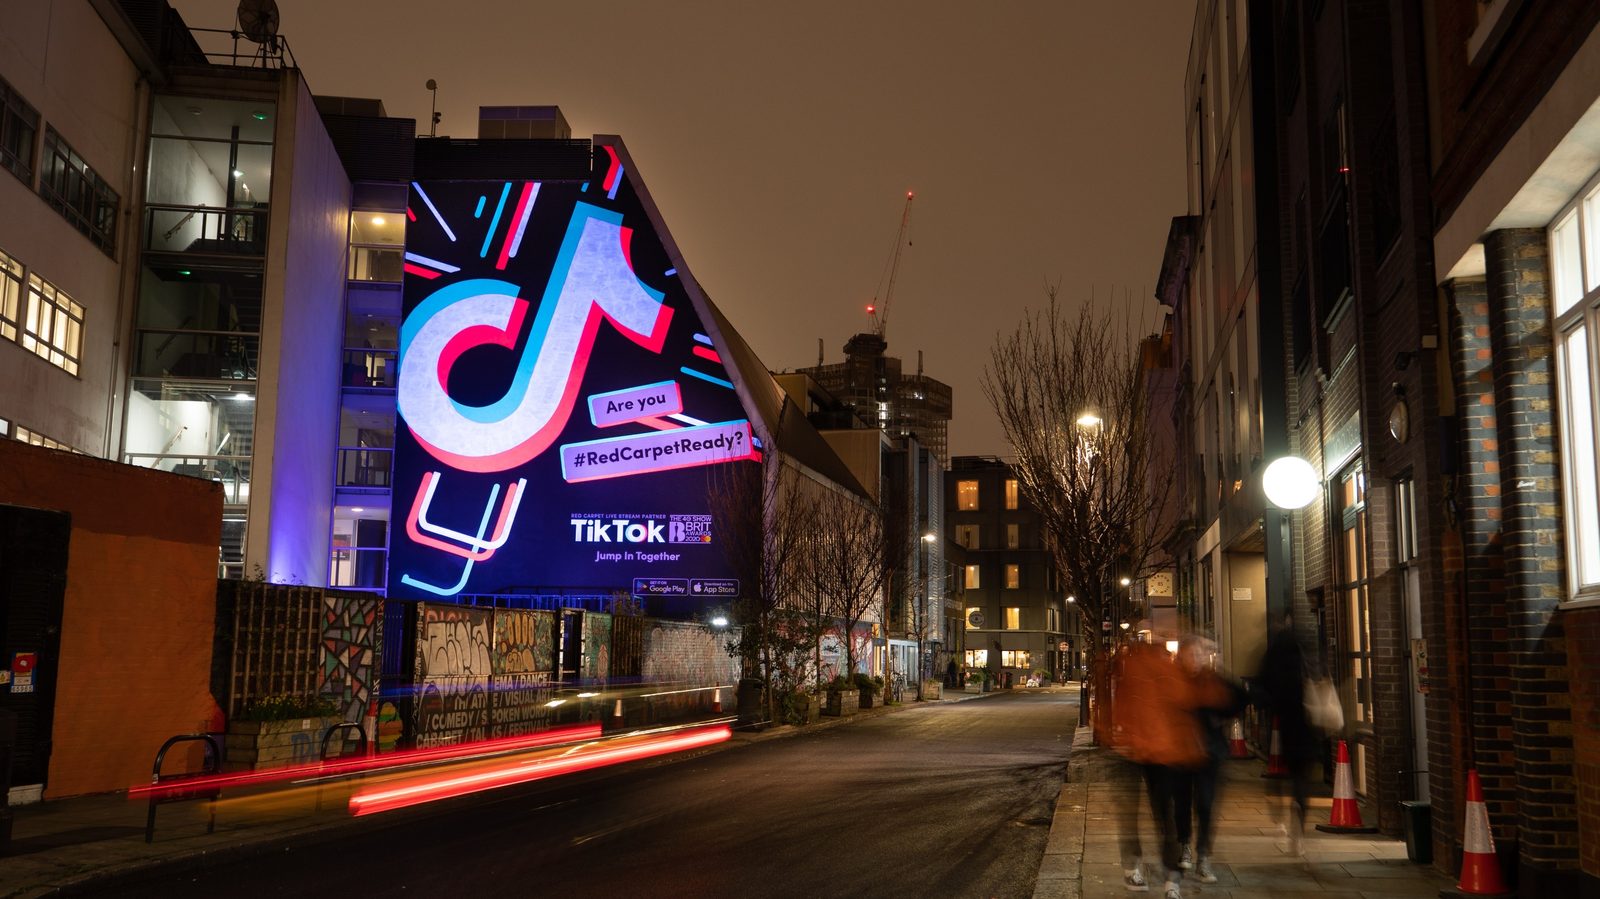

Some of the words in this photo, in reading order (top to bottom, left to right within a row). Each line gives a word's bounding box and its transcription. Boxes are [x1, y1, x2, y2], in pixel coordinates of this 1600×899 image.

[606, 399, 634, 414] Are
[637, 394, 667, 412] you
[573, 430, 744, 467] #RedCarpetReady?
[570, 519, 665, 543] TikTok
[685, 521, 712, 531] BRIT
[595, 550, 622, 562] Jump
[624, 551, 634, 561] In
[635, 551, 681, 563] Together
[649, 585, 672, 593] Google
[672, 585, 686, 593] Play
[703, 586, 718, 594] App
[519, 673, 547, 689] DANCE
[504, 689, 534, 706] VISUAL
[432, 710, 475, 730] COMEDY
[521, 704, 546, 720] WORD
[416, 729, 464, 749] CABARET
[508, 718, 551, 738] FESTIVALS
